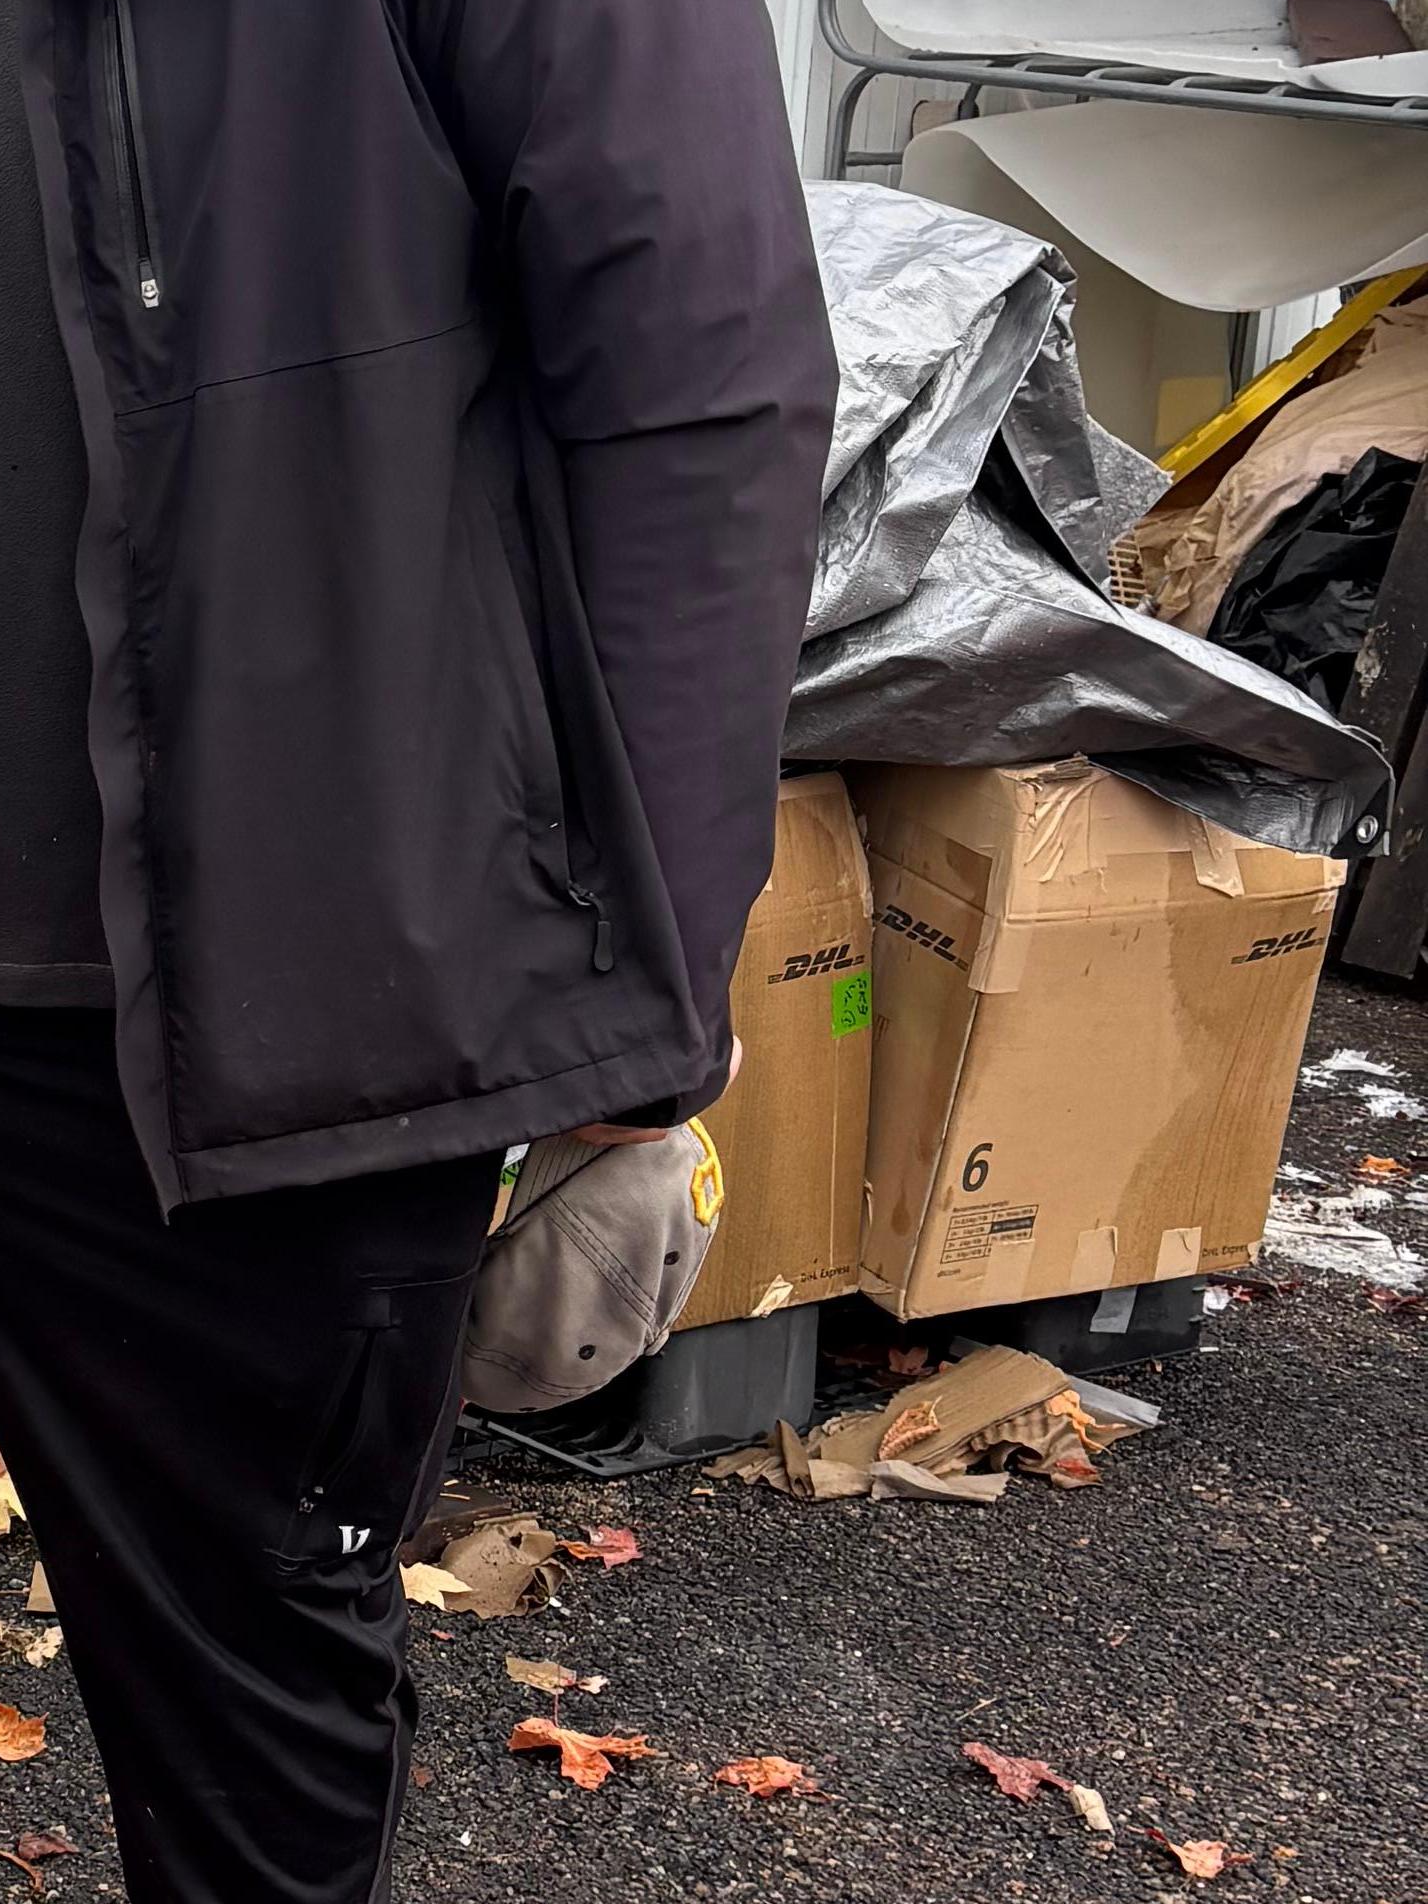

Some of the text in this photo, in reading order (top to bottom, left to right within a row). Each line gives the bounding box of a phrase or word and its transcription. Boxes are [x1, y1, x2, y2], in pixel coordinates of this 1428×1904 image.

[881, 904, 957, 962] DHL
[1245, 926, 1318, 963] DHL
[781, 943, 854, 982] DHL
[962, 1142, 994, 1192] 6
